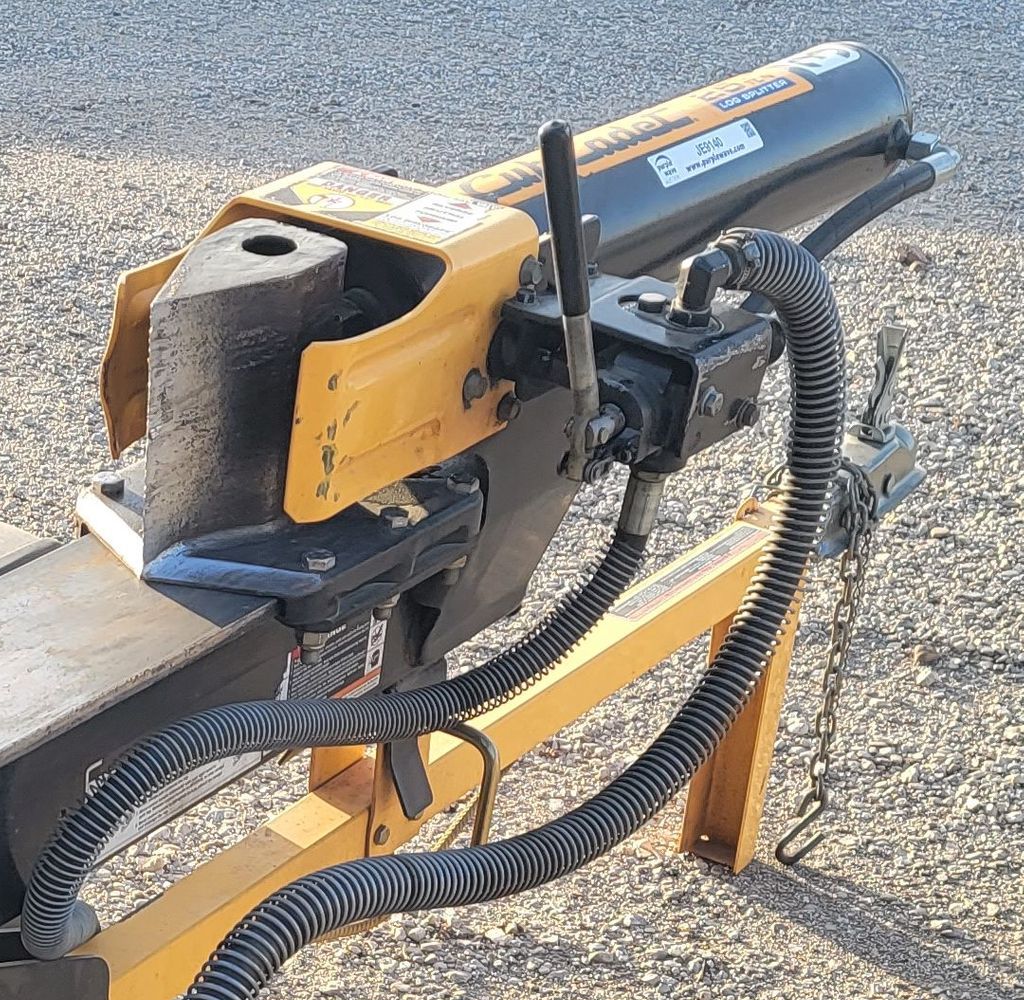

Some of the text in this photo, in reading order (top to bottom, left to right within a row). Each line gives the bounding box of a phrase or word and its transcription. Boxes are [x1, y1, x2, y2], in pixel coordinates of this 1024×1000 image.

[719, 95, 742, 109] LOG
[741, 78, 788, 101] SPLITTER
[695, 136, 724, 156] JE9140
